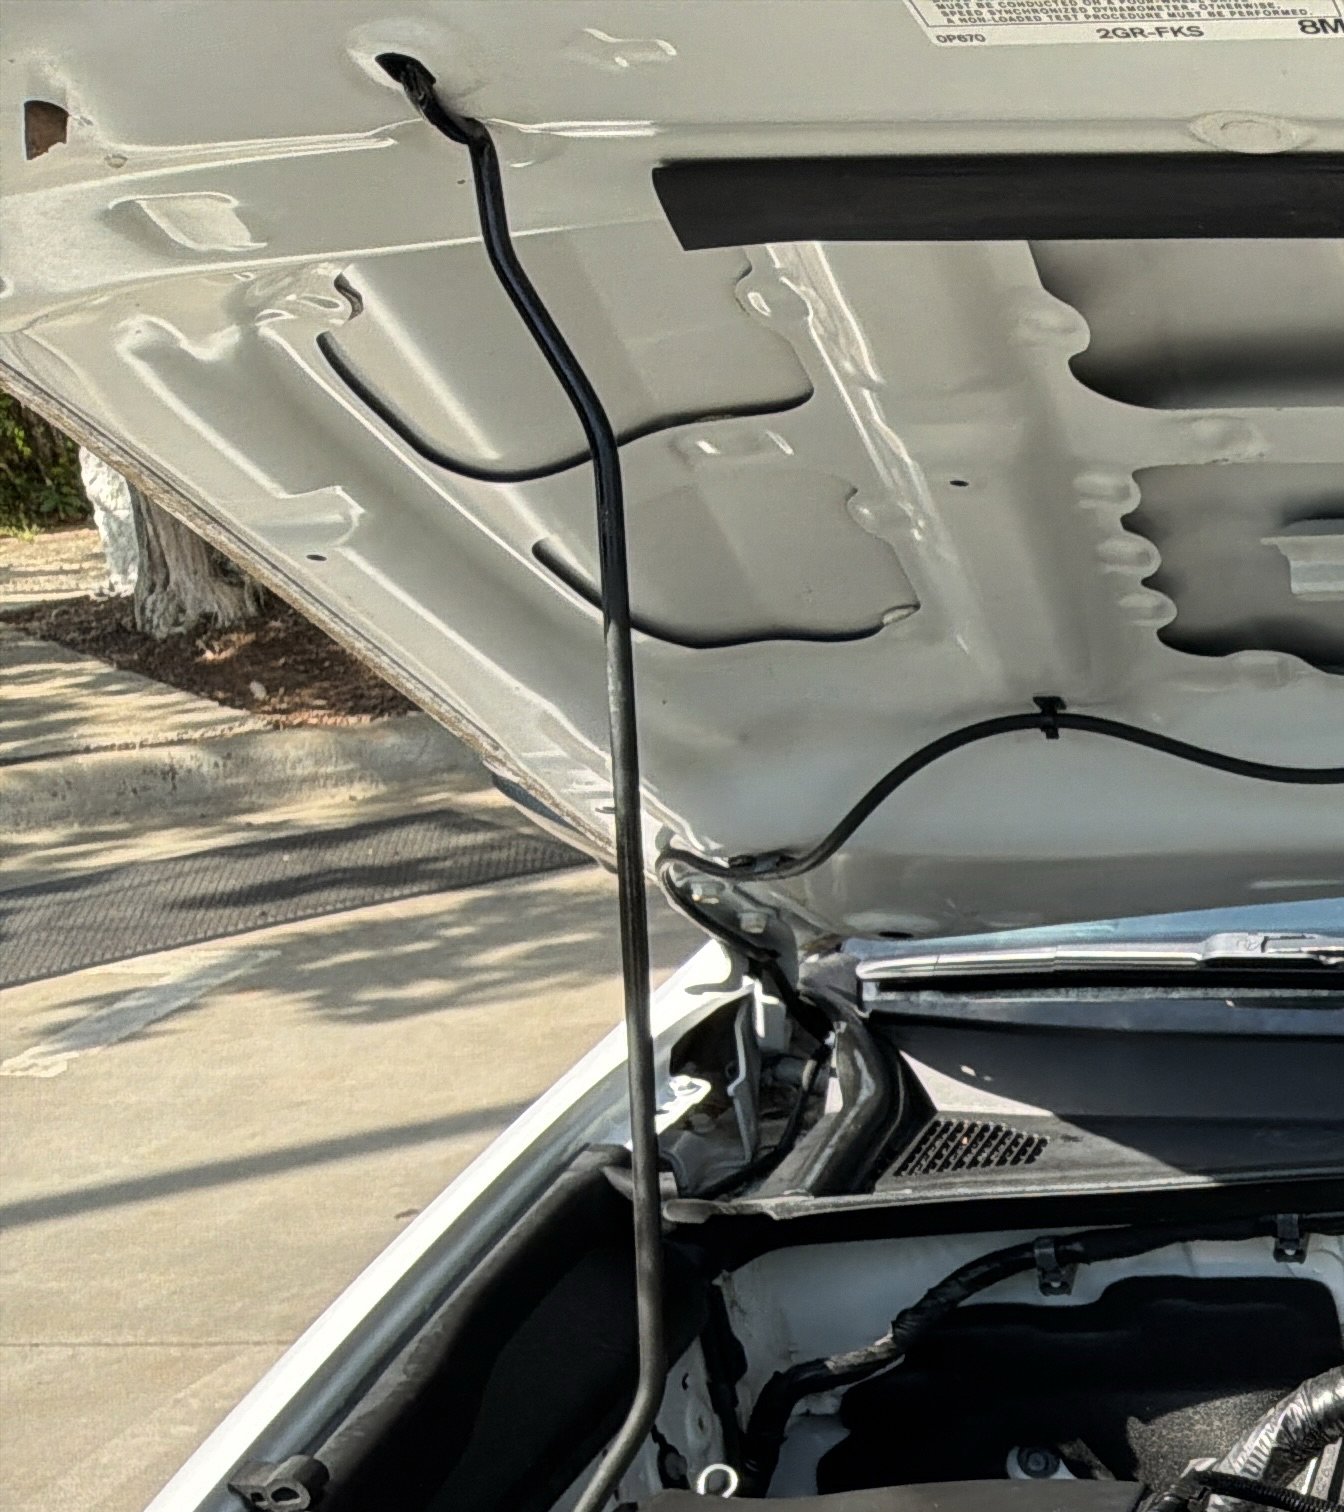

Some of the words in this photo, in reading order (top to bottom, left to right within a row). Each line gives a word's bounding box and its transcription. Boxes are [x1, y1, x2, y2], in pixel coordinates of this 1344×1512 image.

[935, 2, 971, 10] MUST
[940, 9, 983, 17] SPEED
[987, 7, 1088, 16] SYNCHRONIZED
[959, 15, 1042, 24] NON-LOADED
[1047, 14, 1079, 22] TEST
[1083, 12, 1162, 20] PROCEDURE
[1096, 25, 1204, 40] 2GR-FKS
